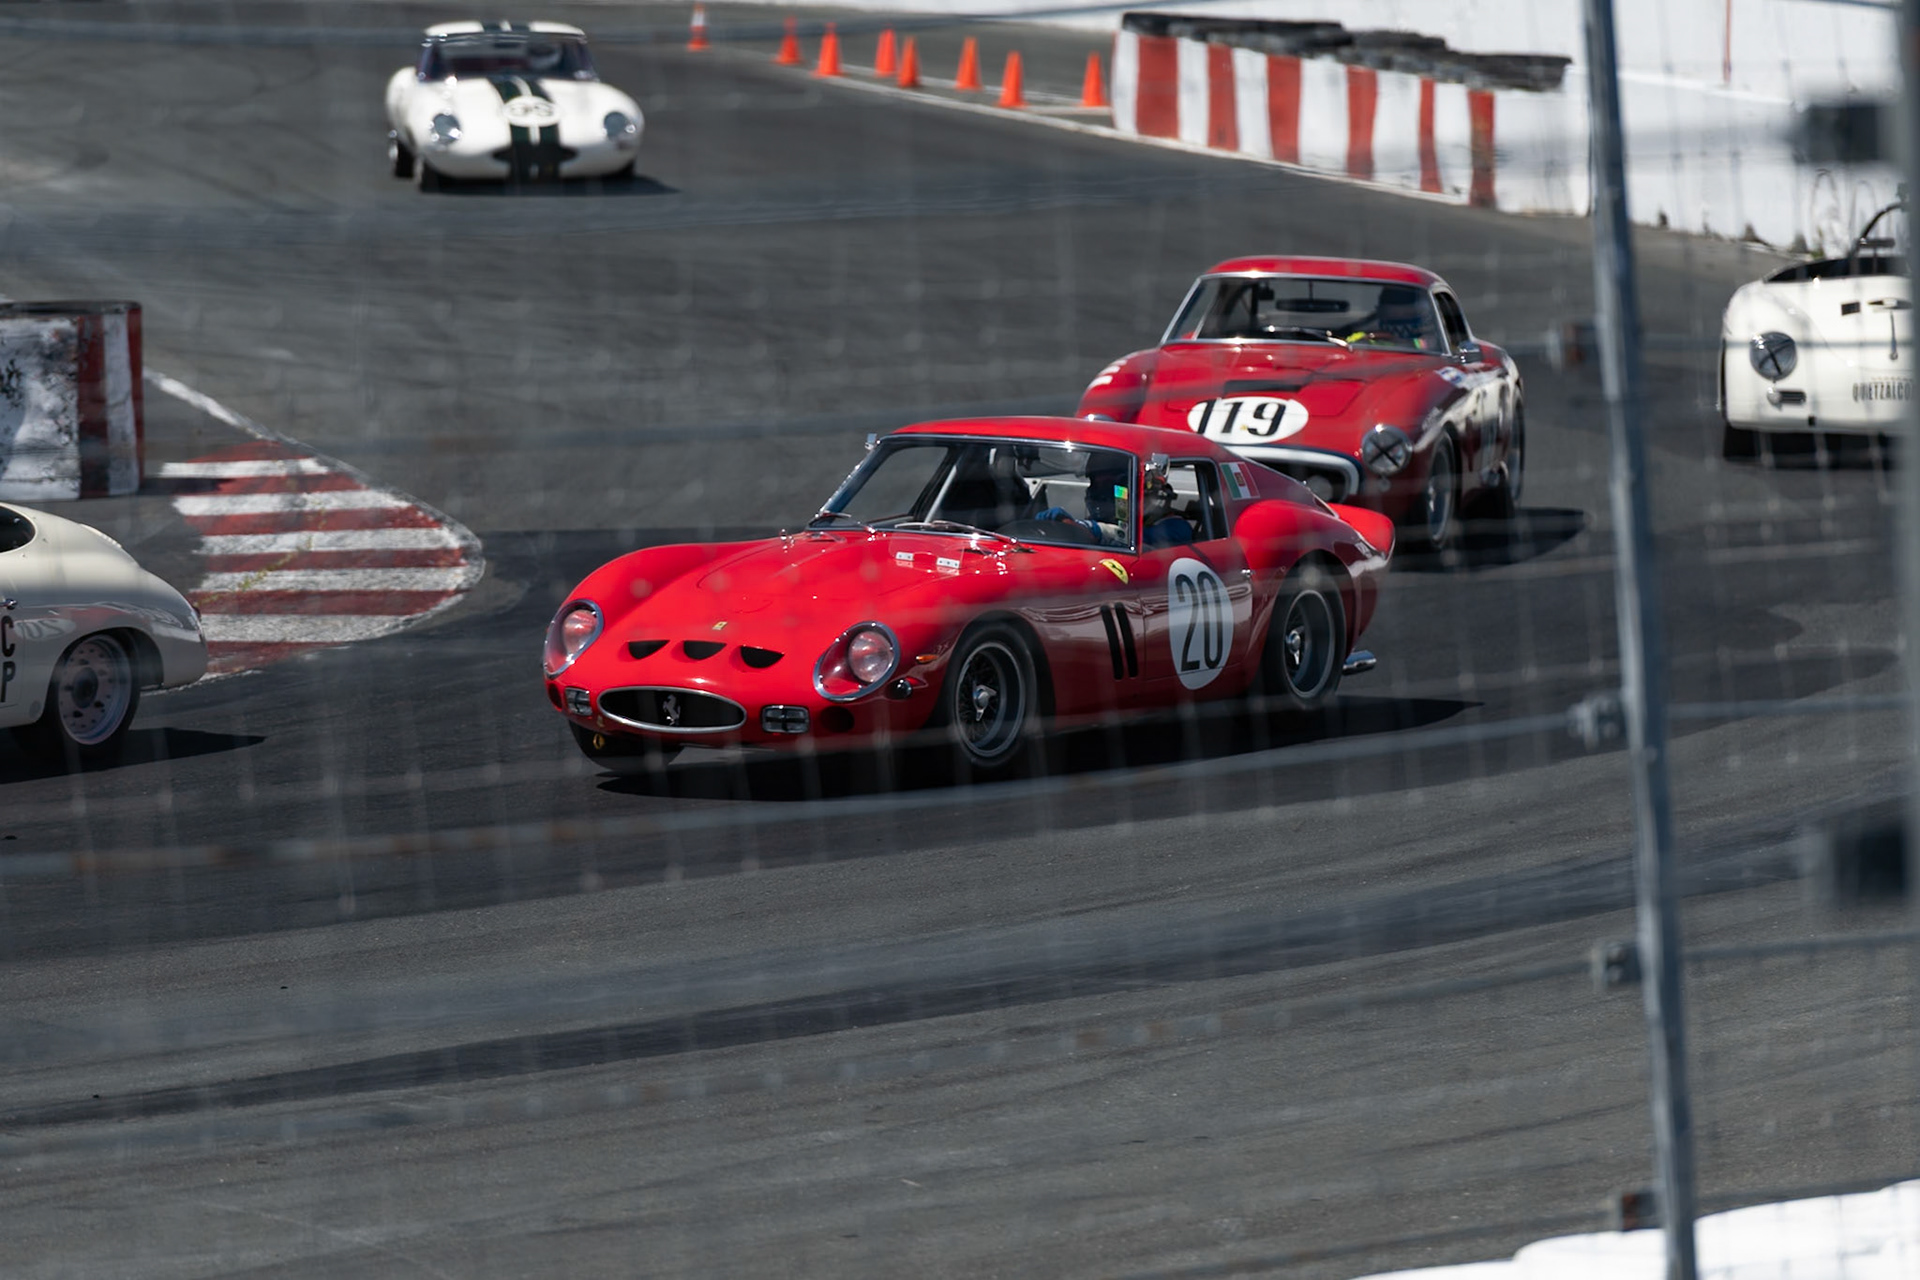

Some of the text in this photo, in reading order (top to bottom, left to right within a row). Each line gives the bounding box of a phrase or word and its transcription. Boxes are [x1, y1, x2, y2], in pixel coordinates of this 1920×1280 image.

[1196, 398, 1287, 437] 119
[1, 615, 15, 657] C
[1175, 571, 1223, 671] 20
[1, 661, 16, 702] P
